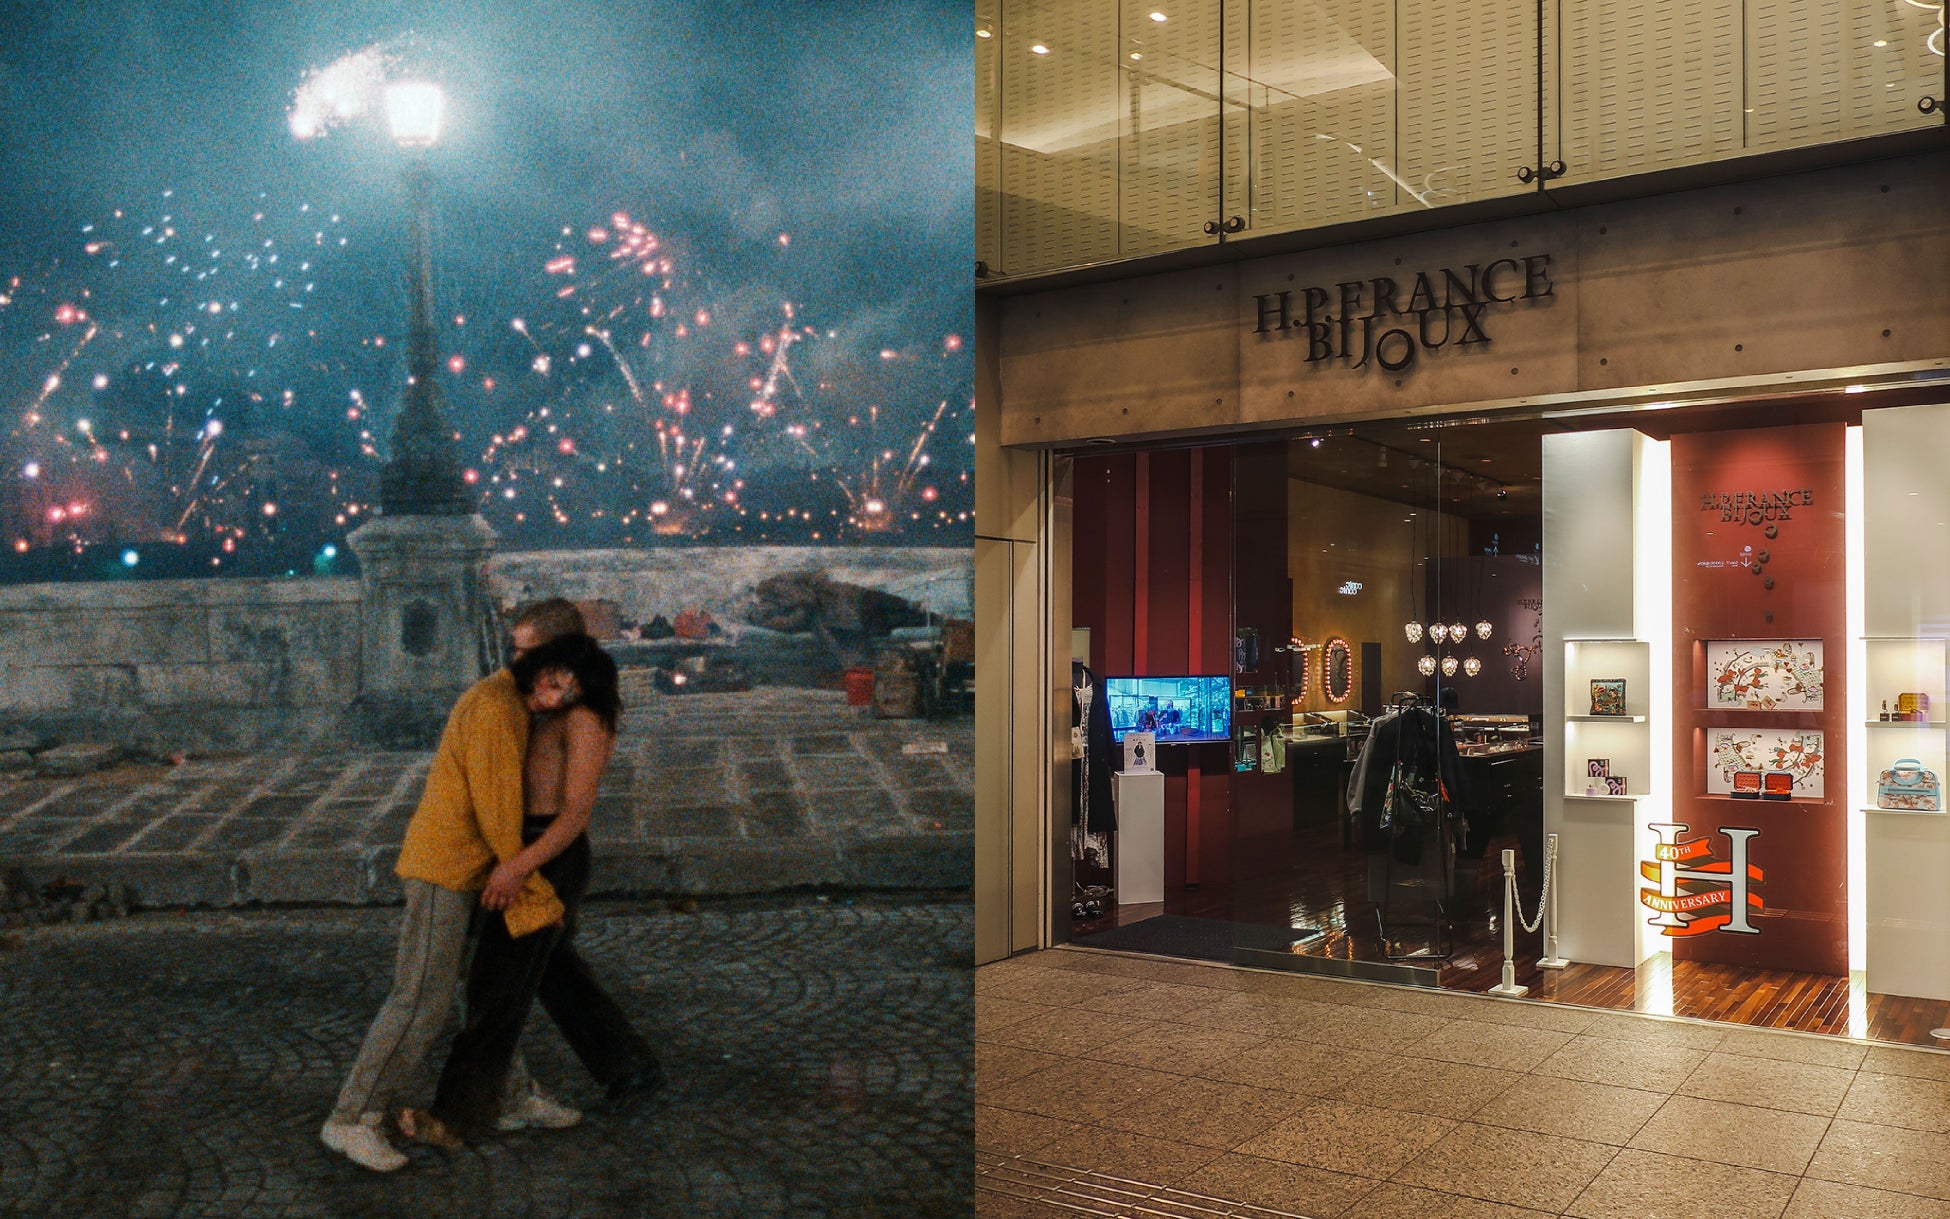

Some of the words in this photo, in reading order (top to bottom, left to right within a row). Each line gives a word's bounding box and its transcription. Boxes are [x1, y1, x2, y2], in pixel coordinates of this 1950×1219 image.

[1303, 302, 1491, 371] BIJOUX
[1721, 506, 1792, 526] BIJOUX
[1659, 846, 1691, 860] 40TH
[1643, 891, 1726, 911] ANNIVERSARY
